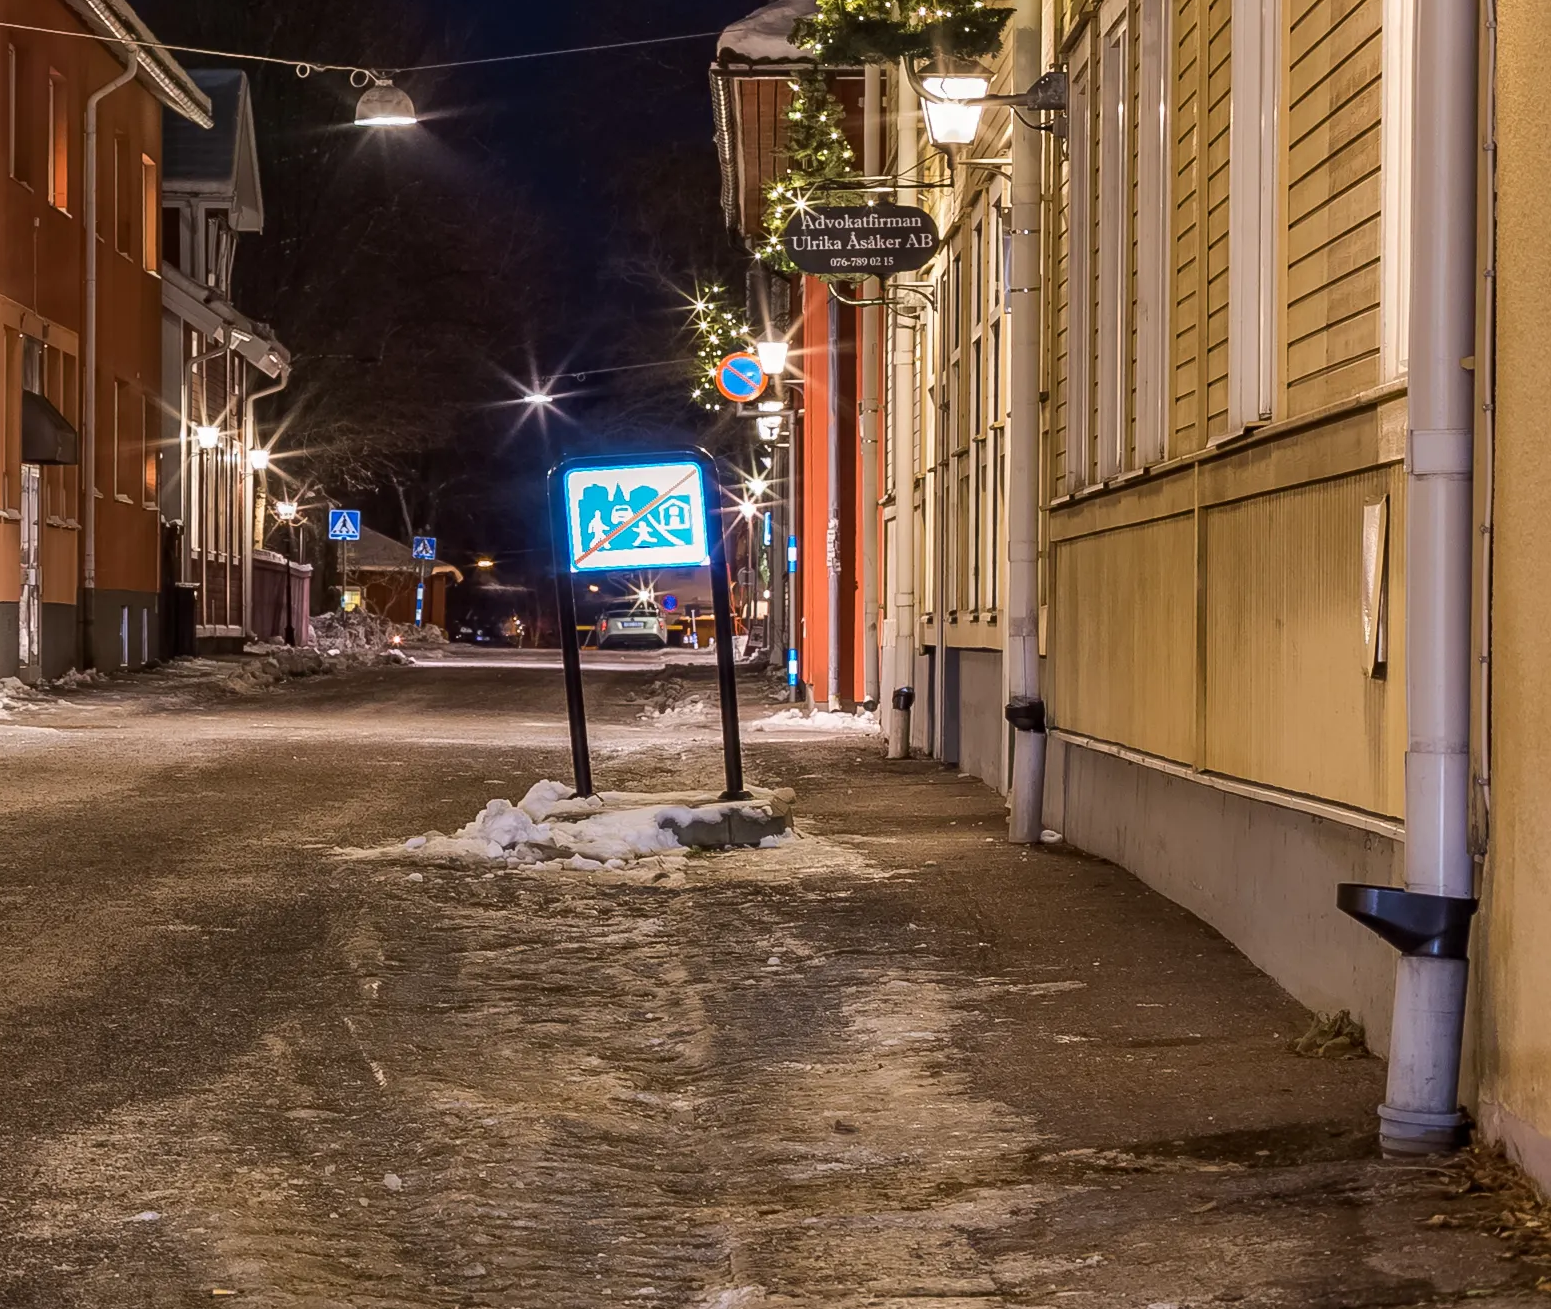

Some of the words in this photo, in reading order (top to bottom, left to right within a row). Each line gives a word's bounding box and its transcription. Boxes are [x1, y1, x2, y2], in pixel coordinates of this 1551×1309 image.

[801, 213, 922, 229] Advokatfirman
[791, 235, 842, 251] Ulrika
[846, 231, 902, 250] Åsåker
[905, 233, 933, 248] AB
[830, 257, 868, 267] 076-789
[869, 256, 882, 266] 02
[884, 256, 894, 266] 15
